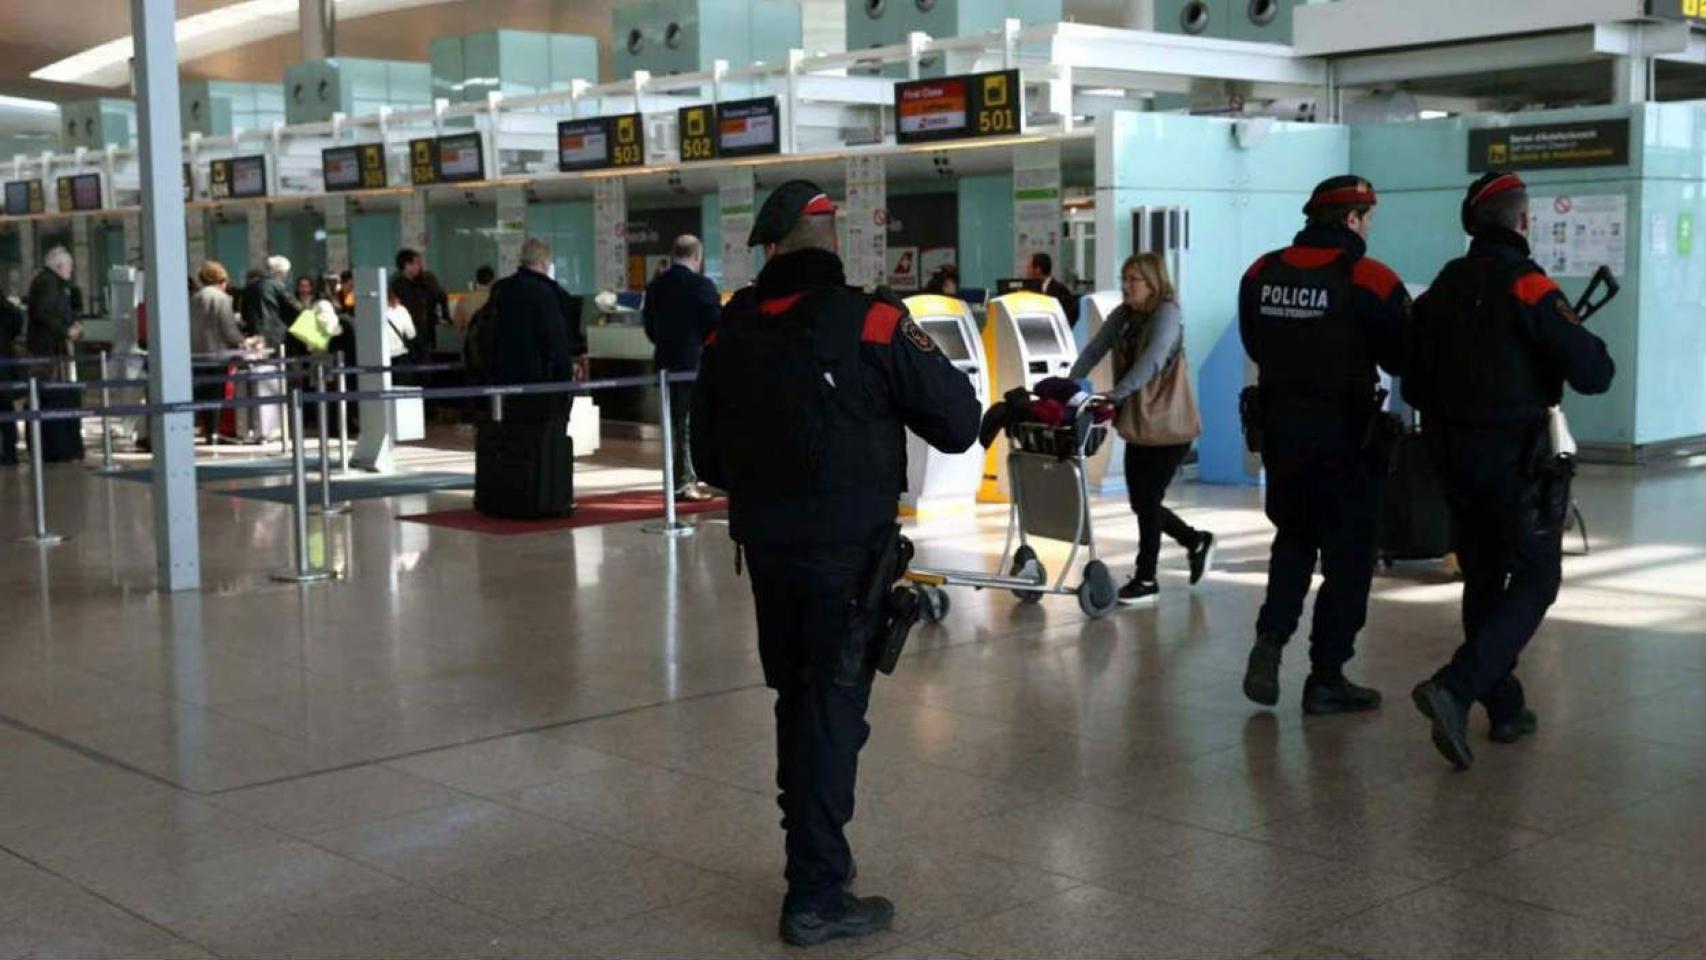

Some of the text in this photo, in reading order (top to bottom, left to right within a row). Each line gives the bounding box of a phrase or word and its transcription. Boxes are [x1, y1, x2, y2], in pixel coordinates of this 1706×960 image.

[980, 108, 1014, 132] 501
[614, 144, 641, 165] 503
[682, 137, 712, 159] 502
[1261, 285, 1328, 308] POLICIA
